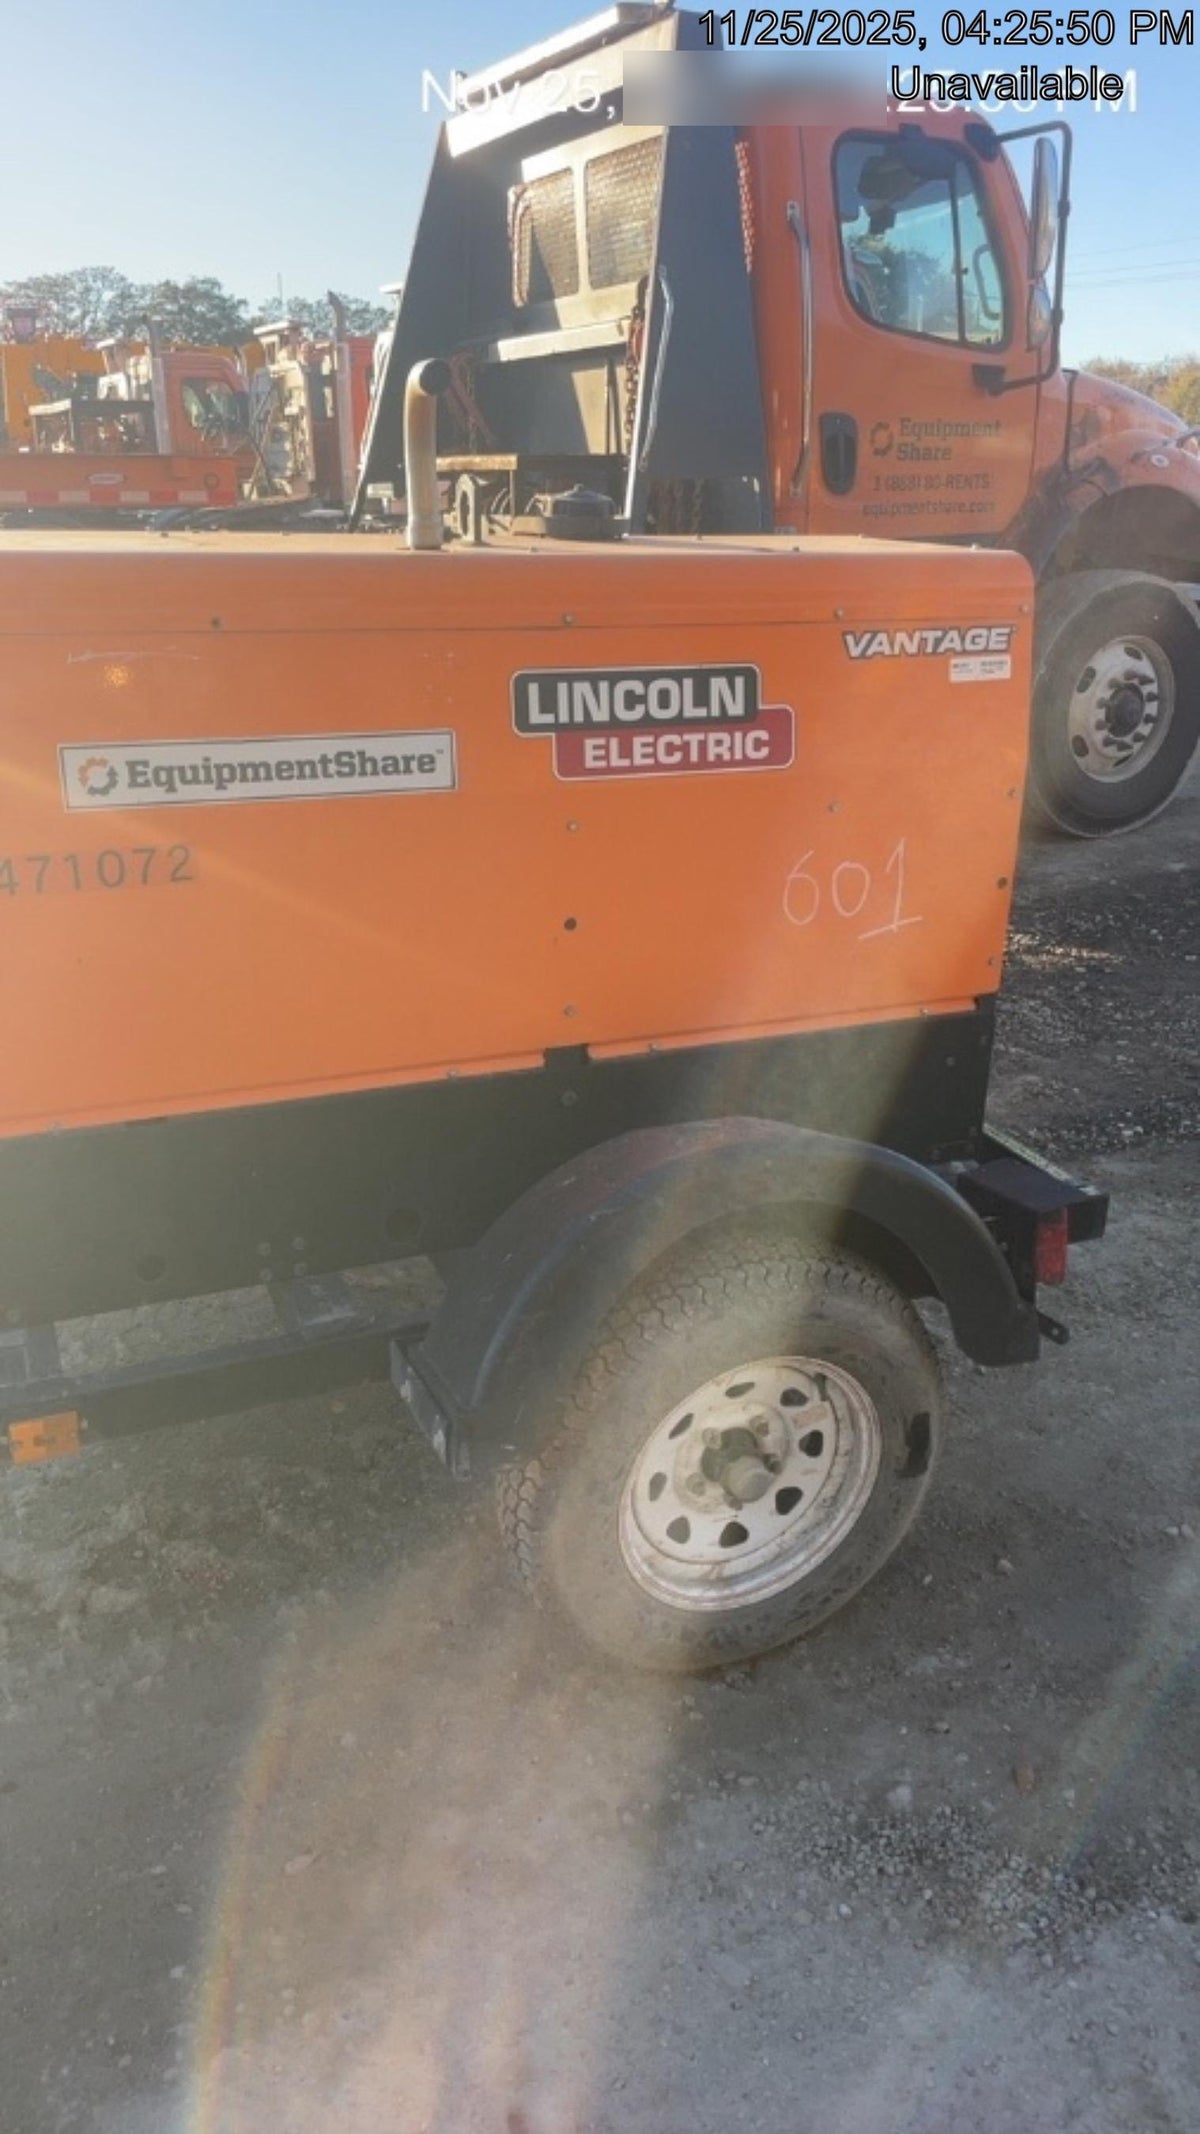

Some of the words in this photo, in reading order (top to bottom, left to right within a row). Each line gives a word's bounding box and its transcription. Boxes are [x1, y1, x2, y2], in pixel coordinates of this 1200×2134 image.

[900, 417, 1001, 441] Equipment
[896, 443, 951, 461] Share
[843, 626, 1012, 659] VANTAGE
[527, 675, 746, 724] LINCOLN
[583, 729, 770, 769] ELECTRIC
[125, 750, 437, 793] EquipmentShare
[782, 837, 923, 940] 601
